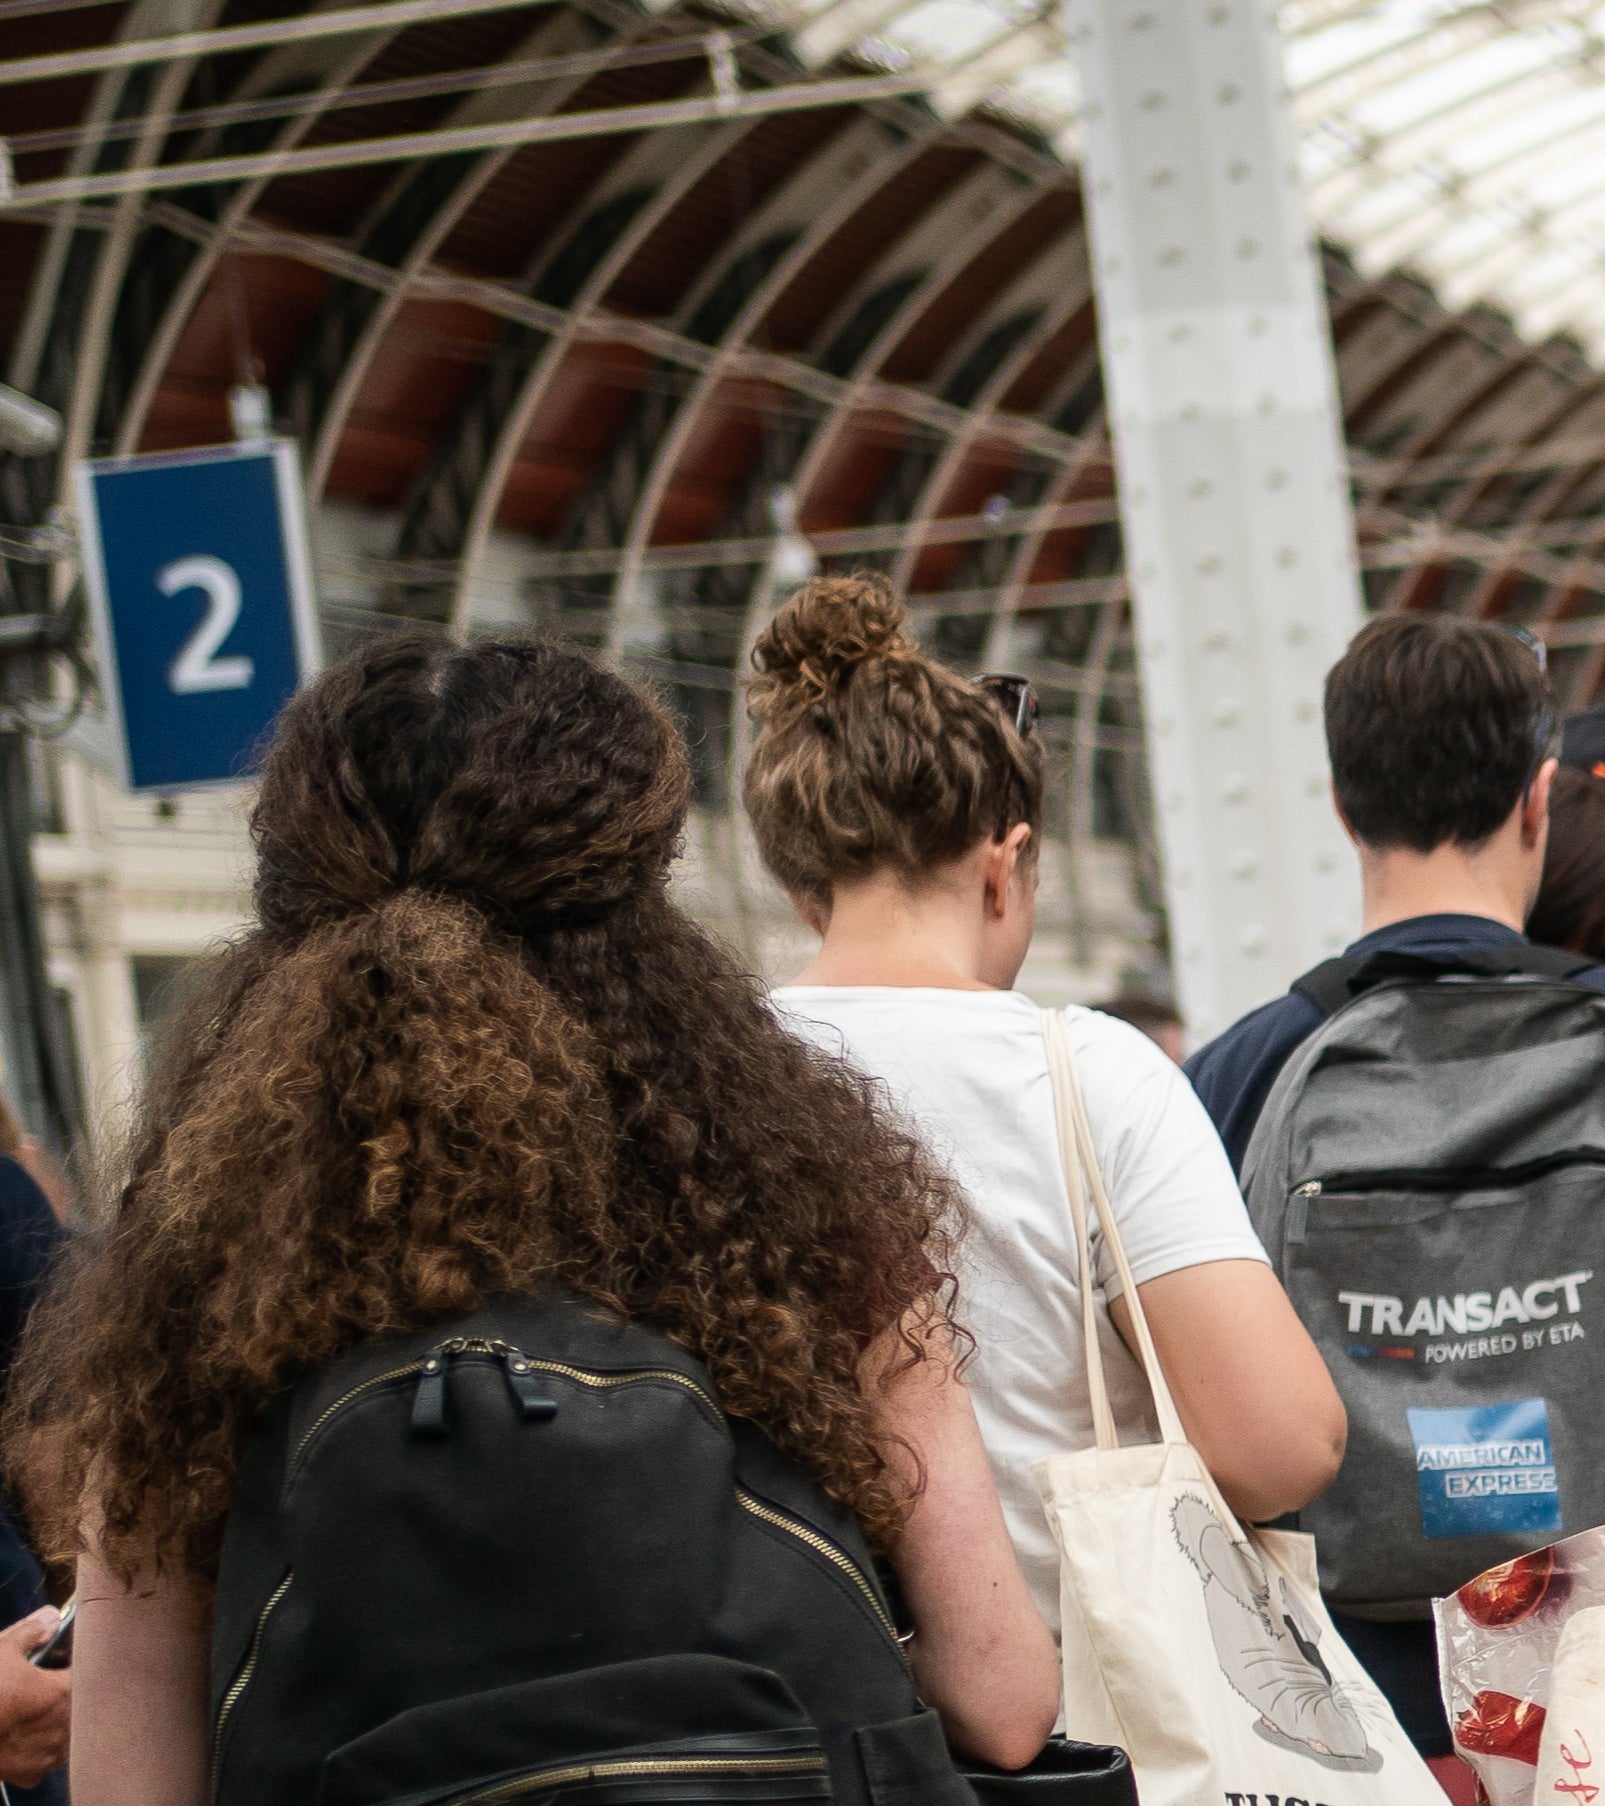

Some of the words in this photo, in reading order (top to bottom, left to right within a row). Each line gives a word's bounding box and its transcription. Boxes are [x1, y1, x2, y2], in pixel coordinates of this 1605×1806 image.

[156, 554, 254, 695] 2
[1338, 1269, 1594, 1337] TRANSACT
[1425, 1334, 1517, 1364] POWERED
[1522, 1329, 1544, 1351] BY
[1549, 1321, 1585, 1346] ETA
[1417, 1441, 1542, 1470] AMERICAN
[1447, 1469, 1557, 1498] EXPRESS
